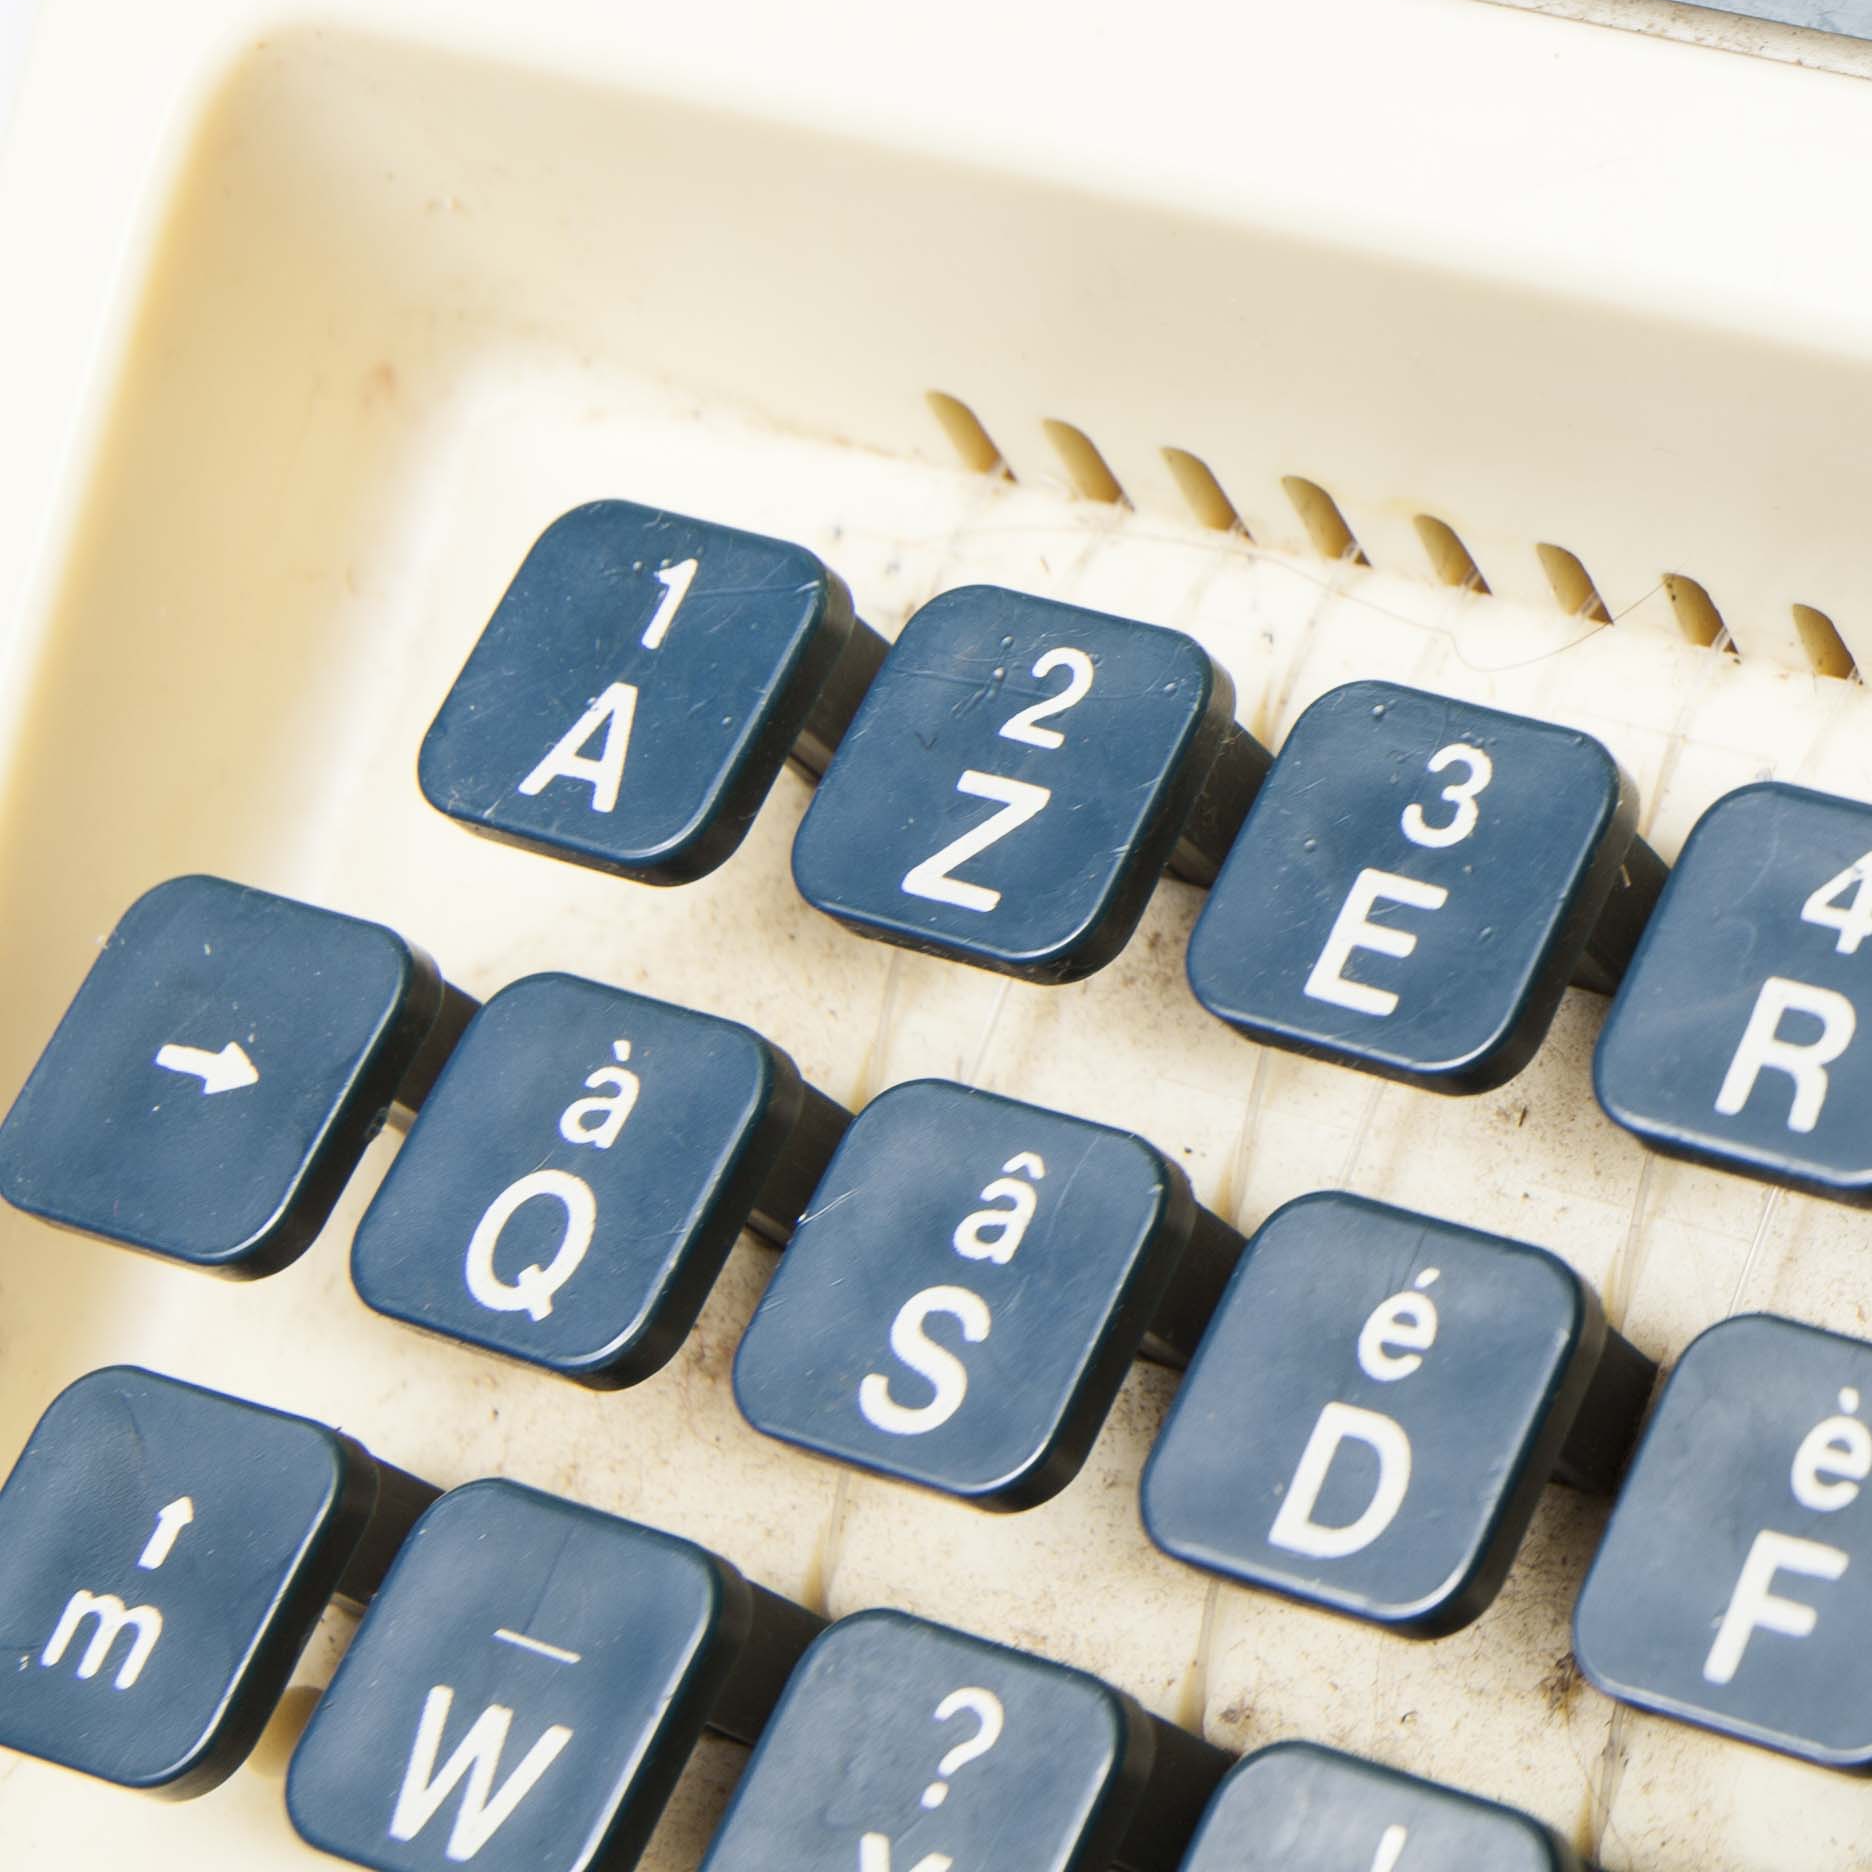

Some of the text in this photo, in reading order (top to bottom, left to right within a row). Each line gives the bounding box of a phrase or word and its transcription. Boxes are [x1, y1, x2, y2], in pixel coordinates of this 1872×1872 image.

[640, 557, 700, 651] 1
[517, 680, 640, 814] A
[998, 645, 1096, 751] 2
[900, 768, 1053, 914] Z
[1400, 741, 1494, 849] 3
[1302, 866, 1450, 1017] E
[558, 1038, 642, 1150] à
[1714, 975, 1858, 1134] R
[464, 1167, 598, 1323] Q
[952, 1150, 1047, 1266] â
[858, 1284, 993, 1436] S
[1357, 1266, 1442, 1382] é
[1268, 1400, 1413, 1559] D
[40, 1588, 165, 1691] m
[1702, 1528, 1850, 1684] F
[388, 1684, 574, 1862] W
[920, 1686, 1005, 1809] ?
